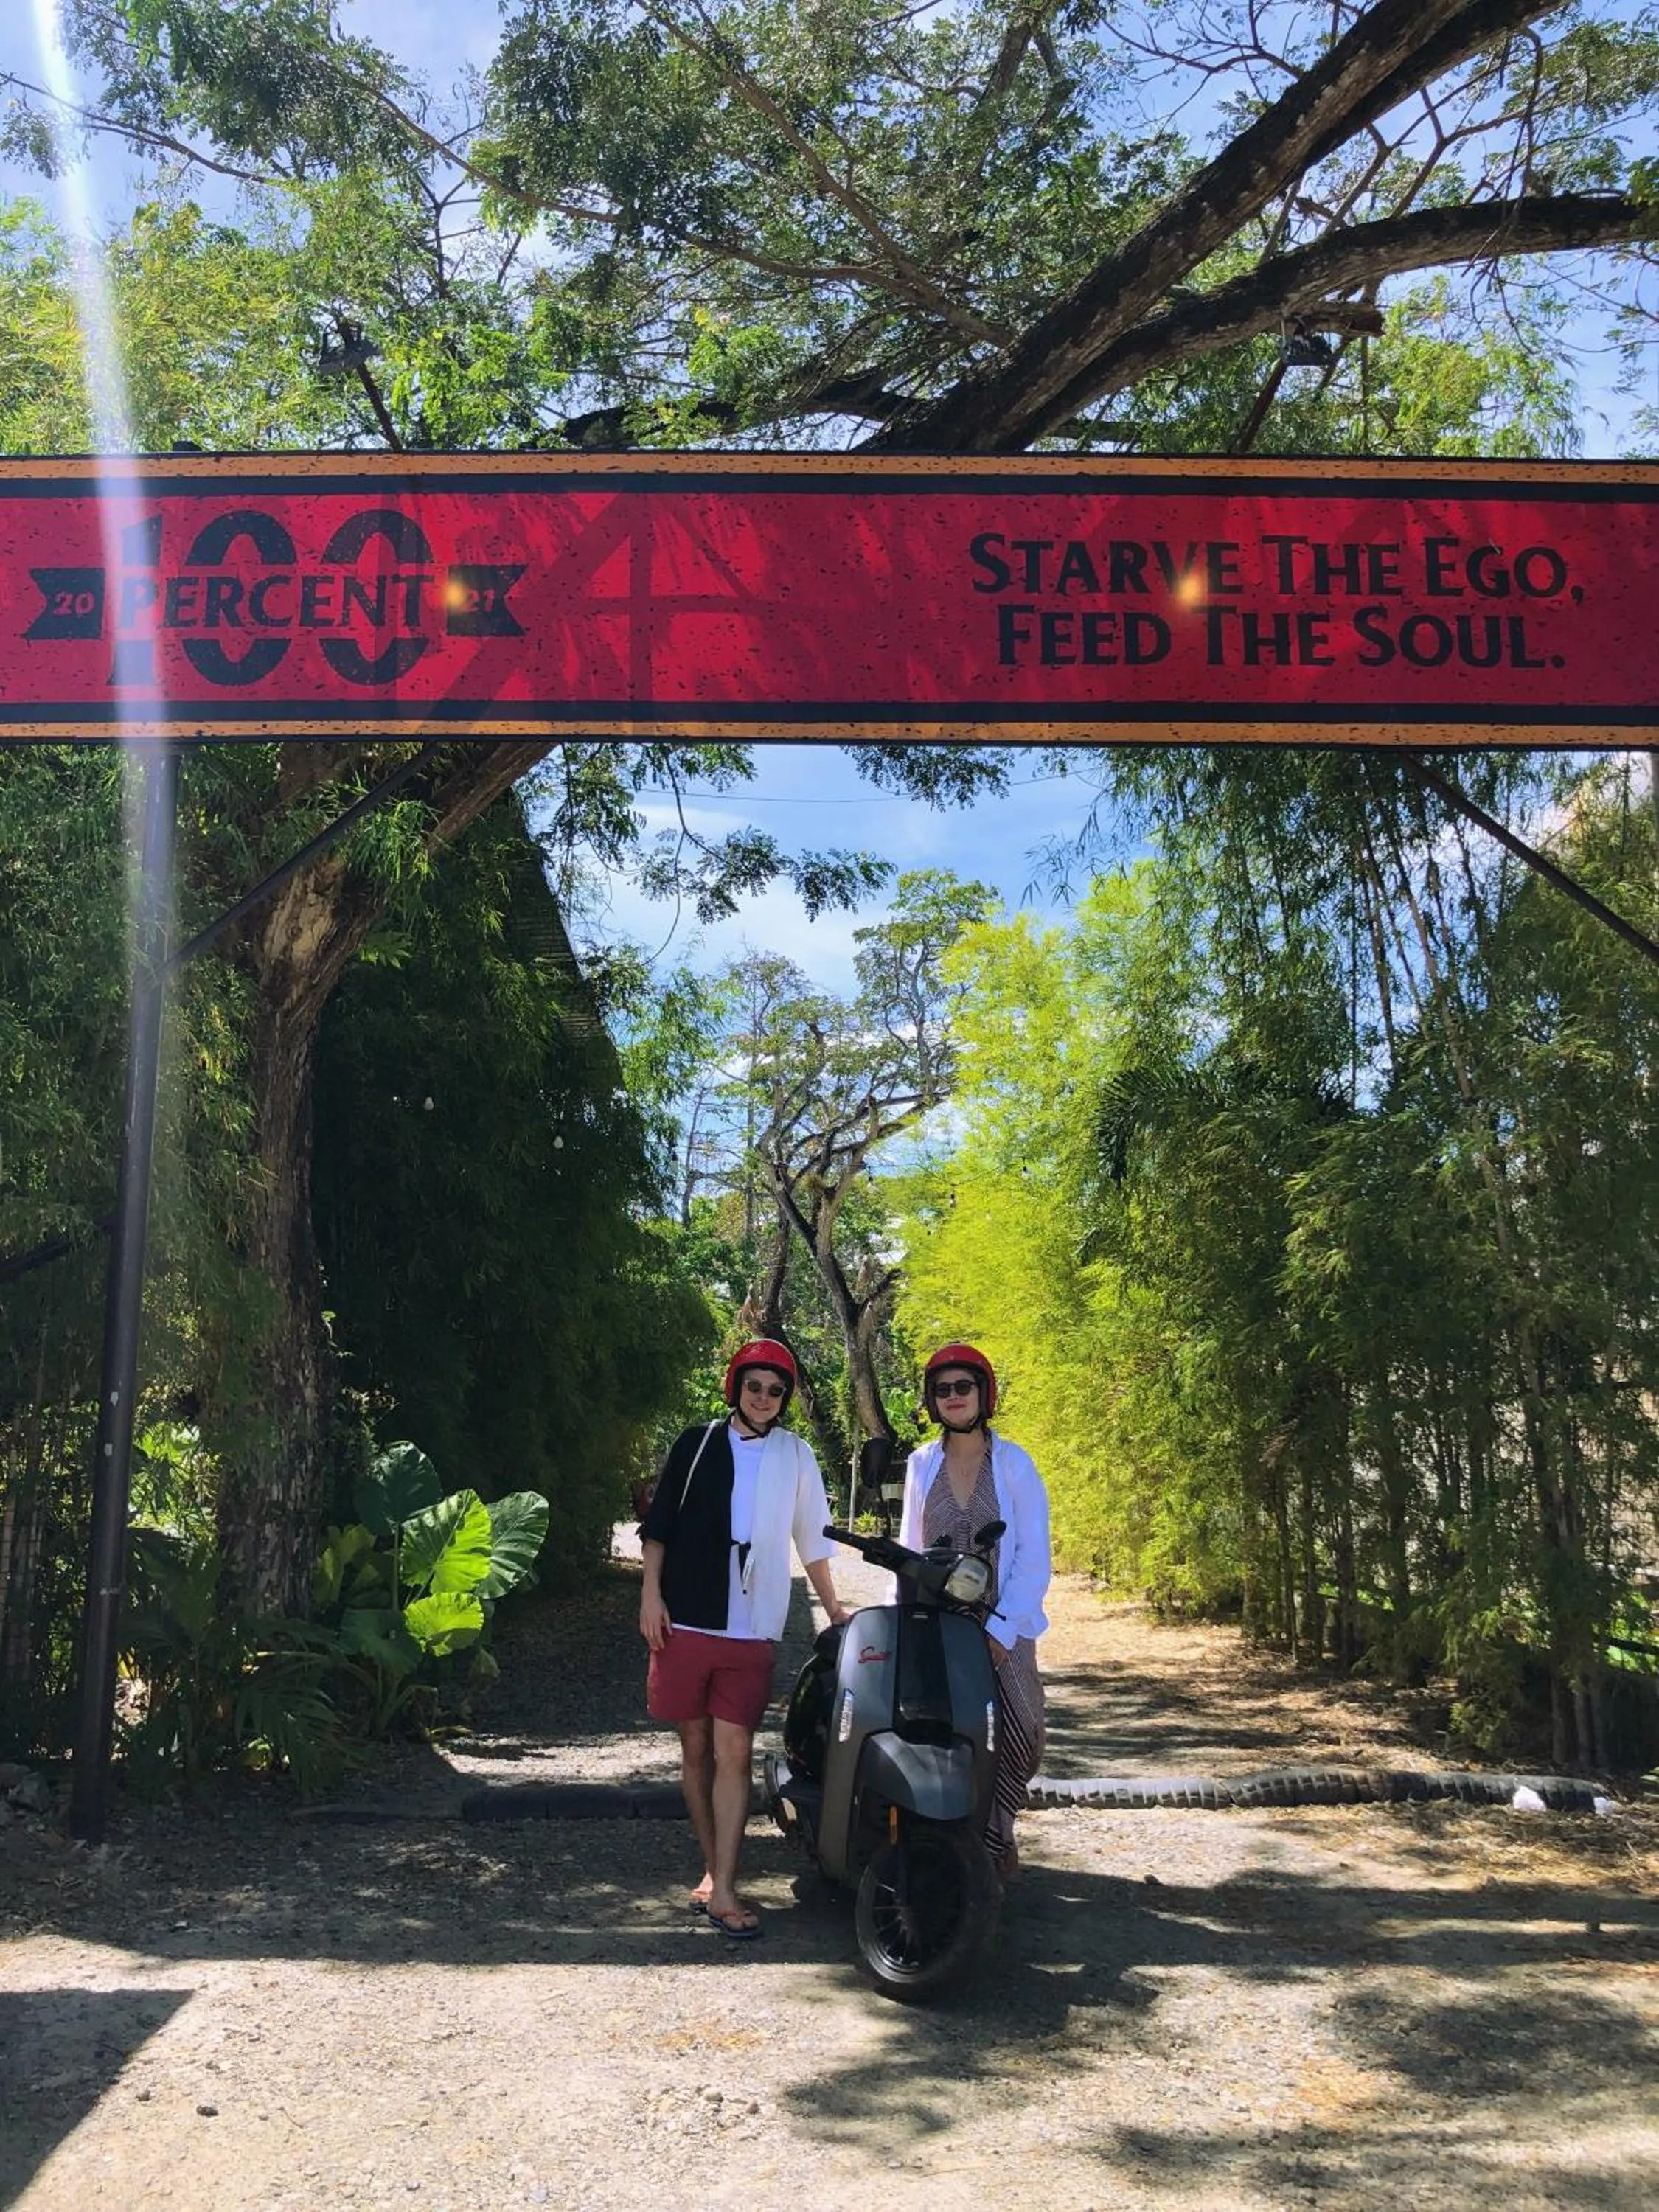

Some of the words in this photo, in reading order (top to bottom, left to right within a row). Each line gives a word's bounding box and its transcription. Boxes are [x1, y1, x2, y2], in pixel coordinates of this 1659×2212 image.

[108, 509, 434, 686] 100
[969, 532, 1243, 596] STARVE
[1262, 535, 1401, 596] THE
[1424, 536, 1584, 605] EGO,
[53, 590, 95, 615] 20
[116, 574, 434, 628] PERCENT
[998, 604, 1172, 665] FEED
[1190, 605, 1335, 666] THE
[1354, 605, 1565, 668] SOUL.
